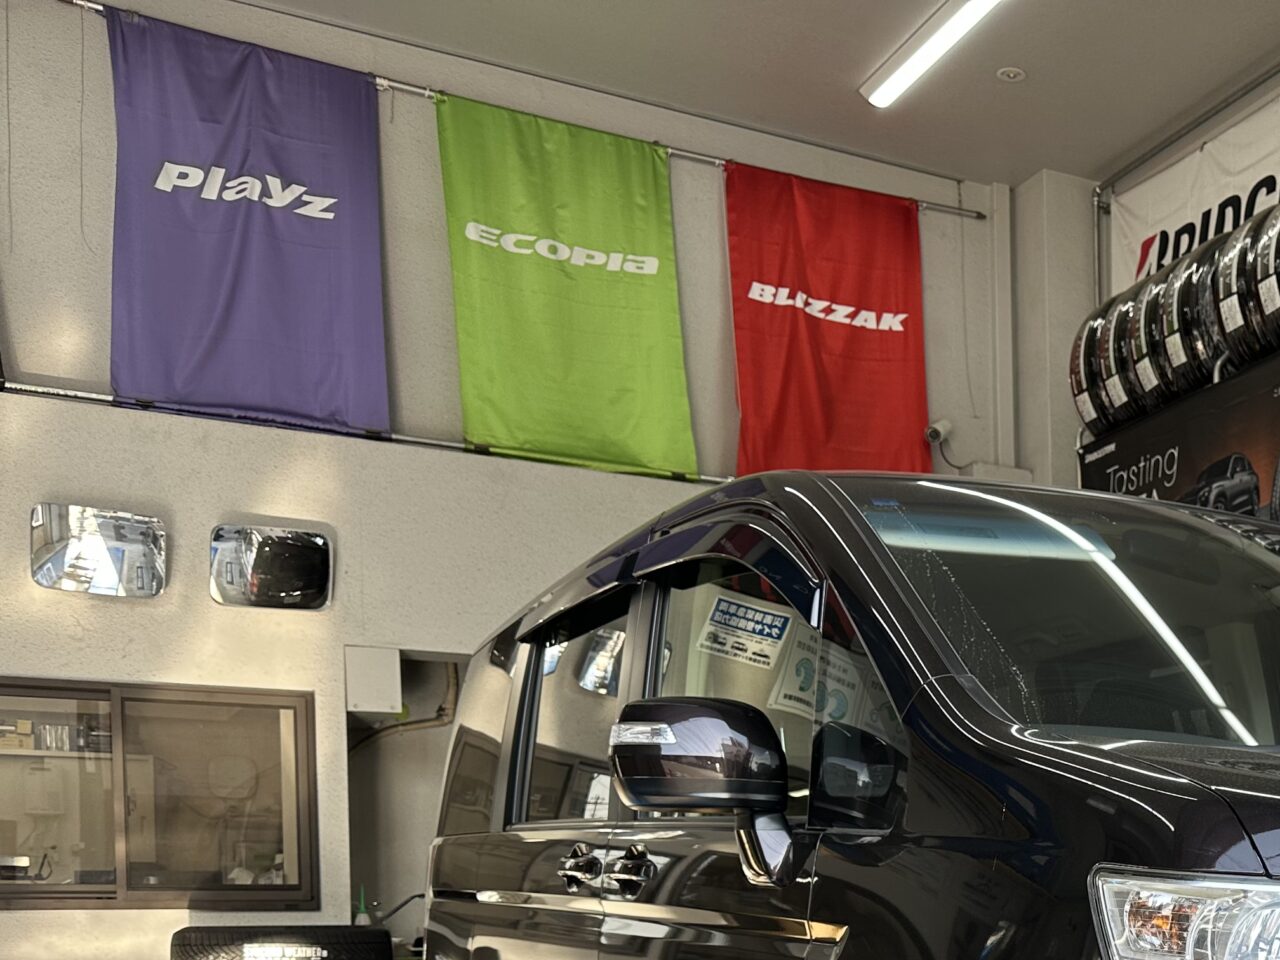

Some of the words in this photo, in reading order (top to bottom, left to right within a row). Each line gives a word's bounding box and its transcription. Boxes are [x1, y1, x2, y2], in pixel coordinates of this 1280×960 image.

[747, 281, 909, 331] BLIZZAK
[1106, 444, 1180, 495] Tasting
[283, 946, 322, 958] WEATHER
